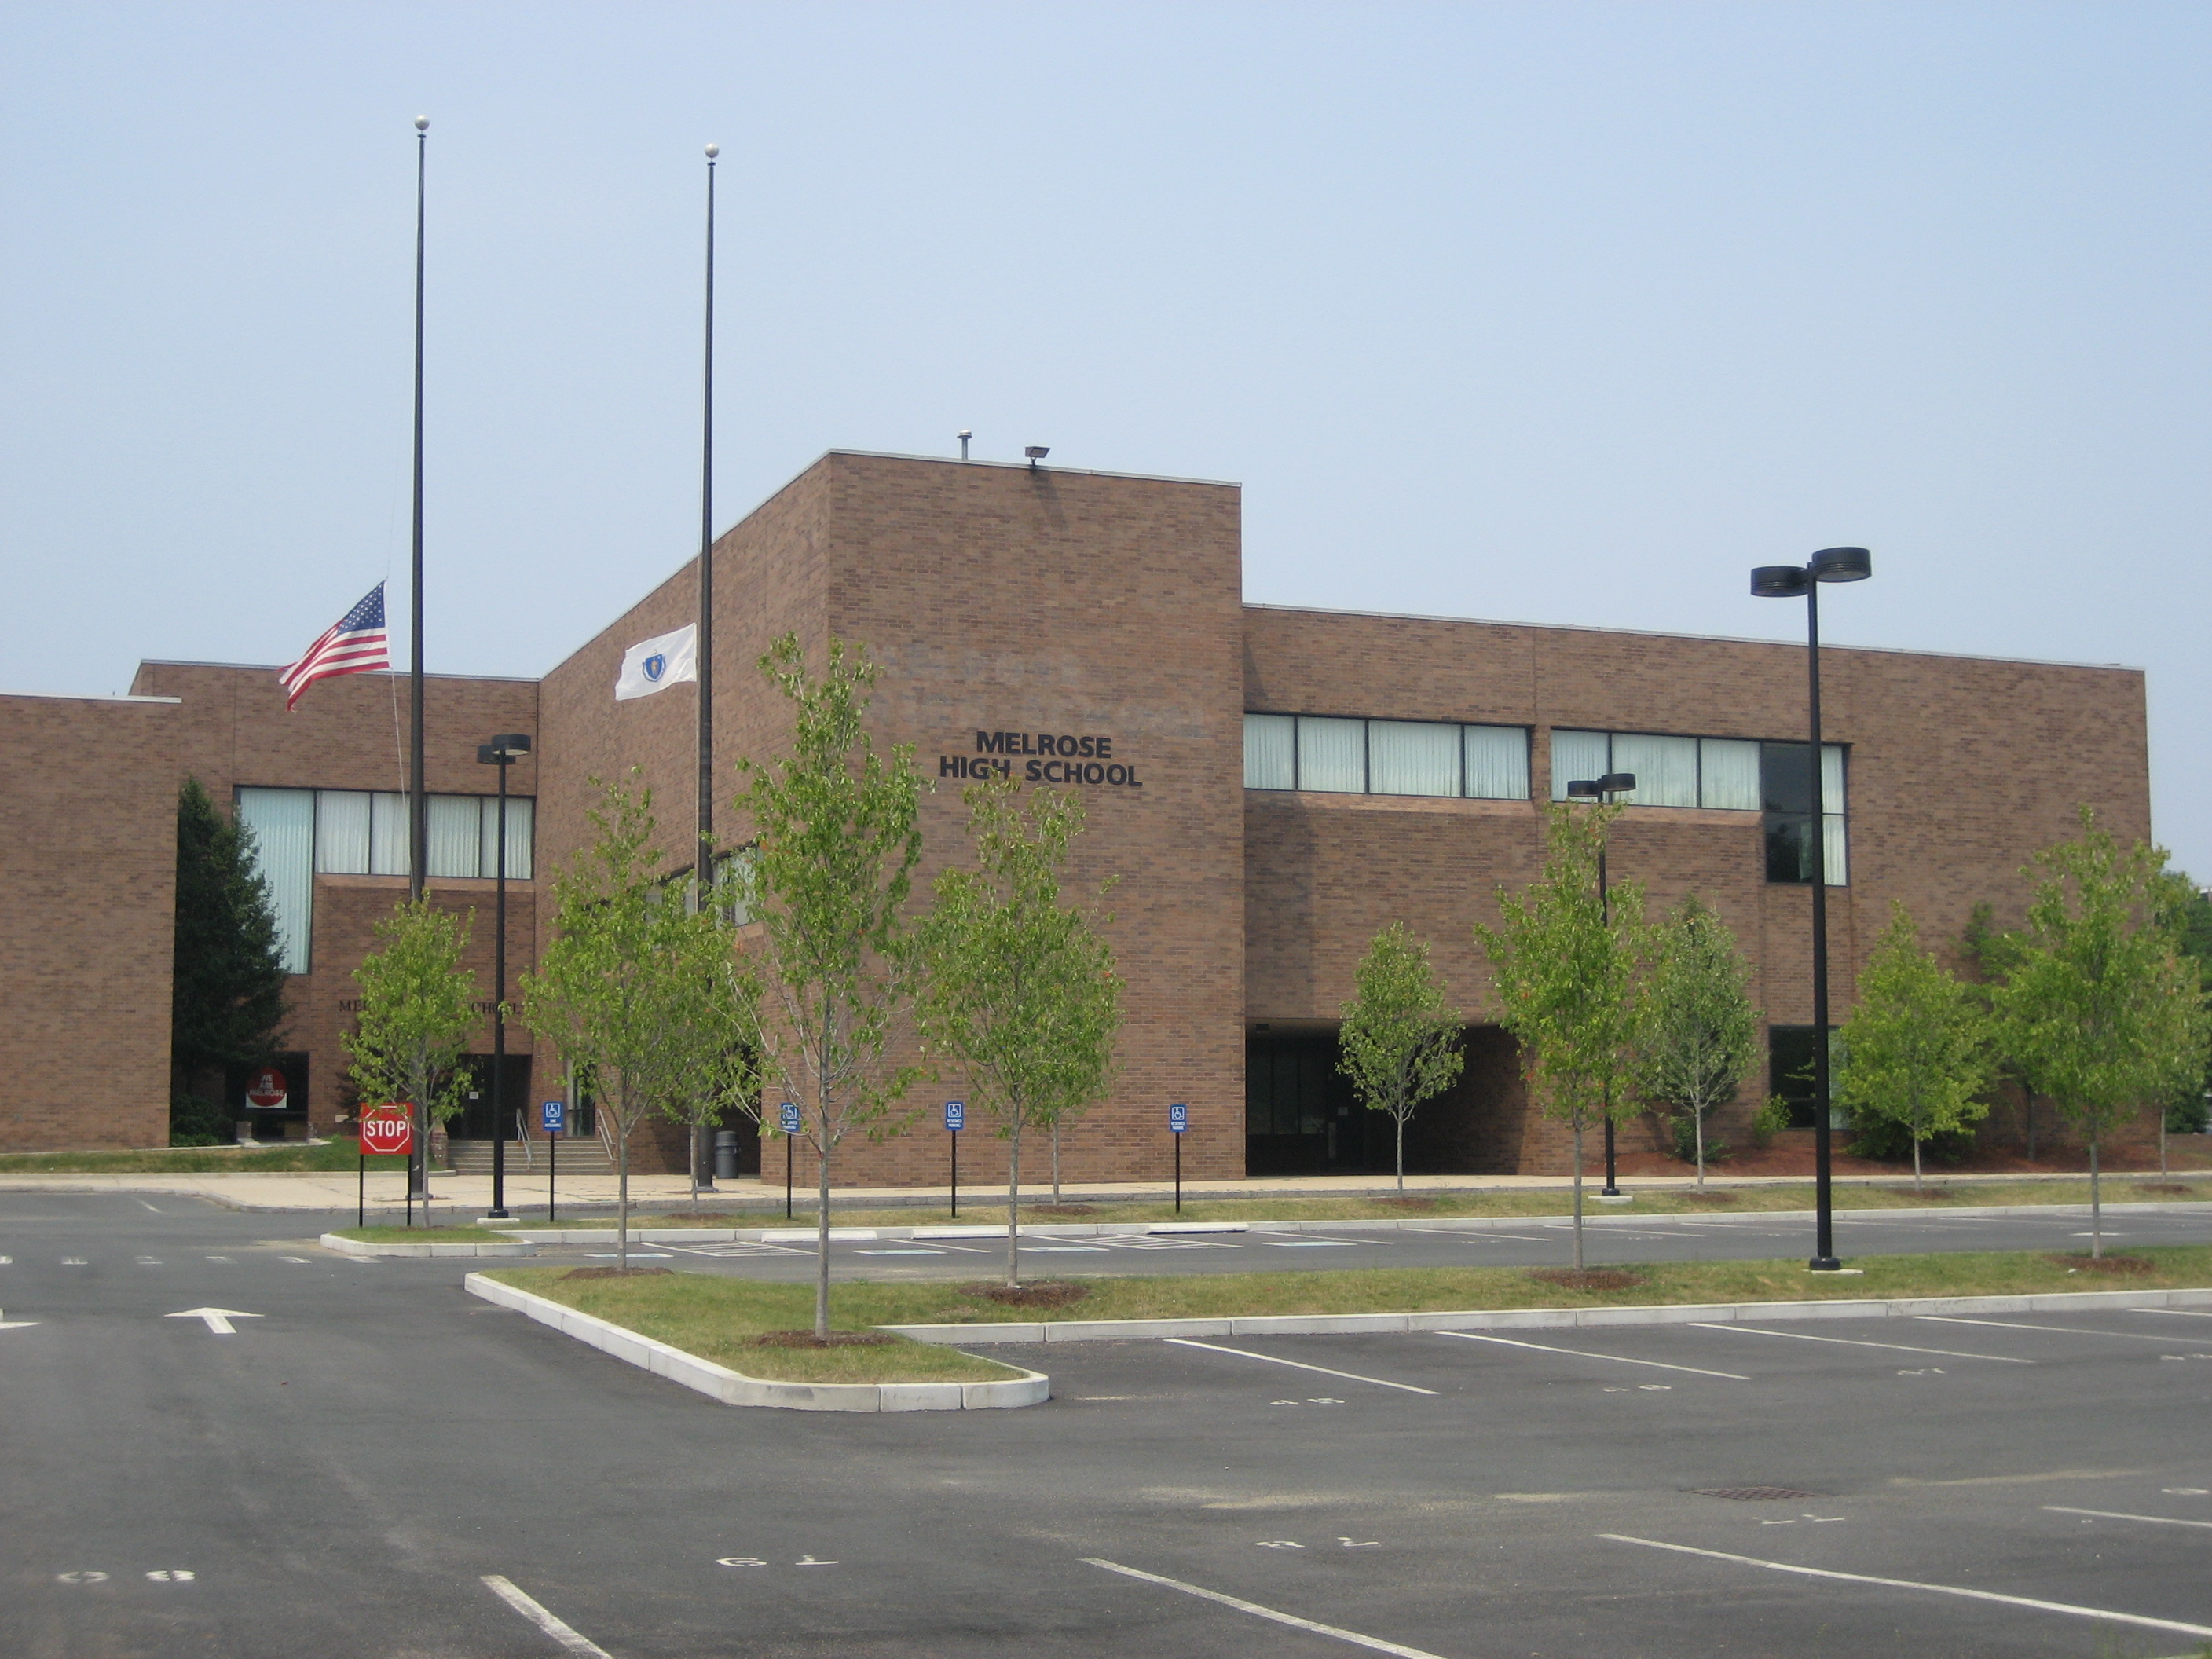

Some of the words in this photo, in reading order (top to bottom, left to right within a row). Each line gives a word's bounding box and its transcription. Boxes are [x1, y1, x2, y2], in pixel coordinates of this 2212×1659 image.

[976, 731, 1111, 758] MELROSE
[939, 756, 1011, 779] HIGH
[1025, 760, 1143, 786] SCHOOL
[366, 1120, 406, 1137] STOP
